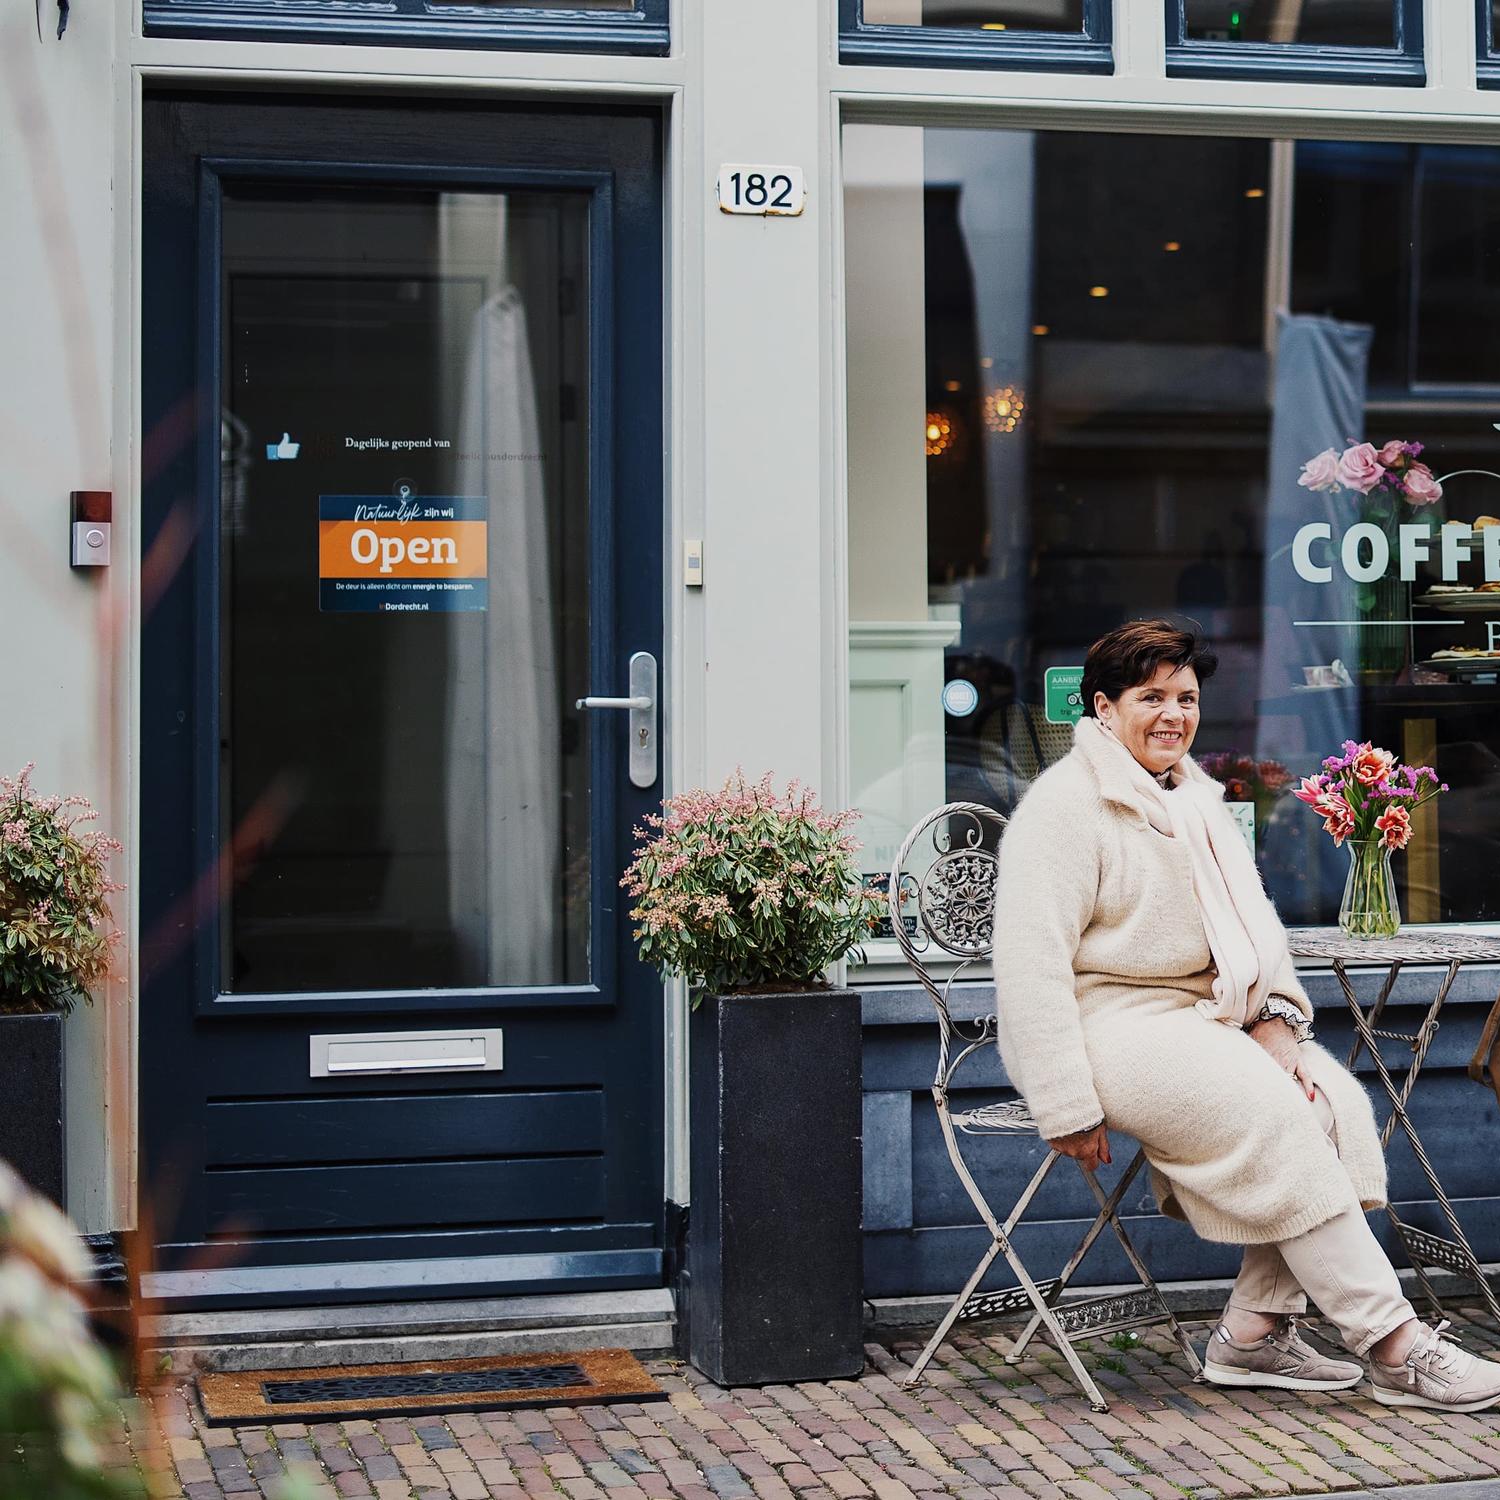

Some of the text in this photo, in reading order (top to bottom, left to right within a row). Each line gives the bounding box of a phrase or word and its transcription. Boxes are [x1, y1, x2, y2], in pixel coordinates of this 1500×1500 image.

[730, 172, 793, 208] 182
[345, 437, 390, 450] Dagelijks
[391, 437, 432, 450] geopend
[433, 440, 451, 448] van
[354, 502, 454, 525] Natuurlijk zijn wij
[350, 527, 459, 573] Open
[367, 582, 385, 590] alleen
[386, 582, 401, 590] dicht
[413, 583, 436, 591] energie
